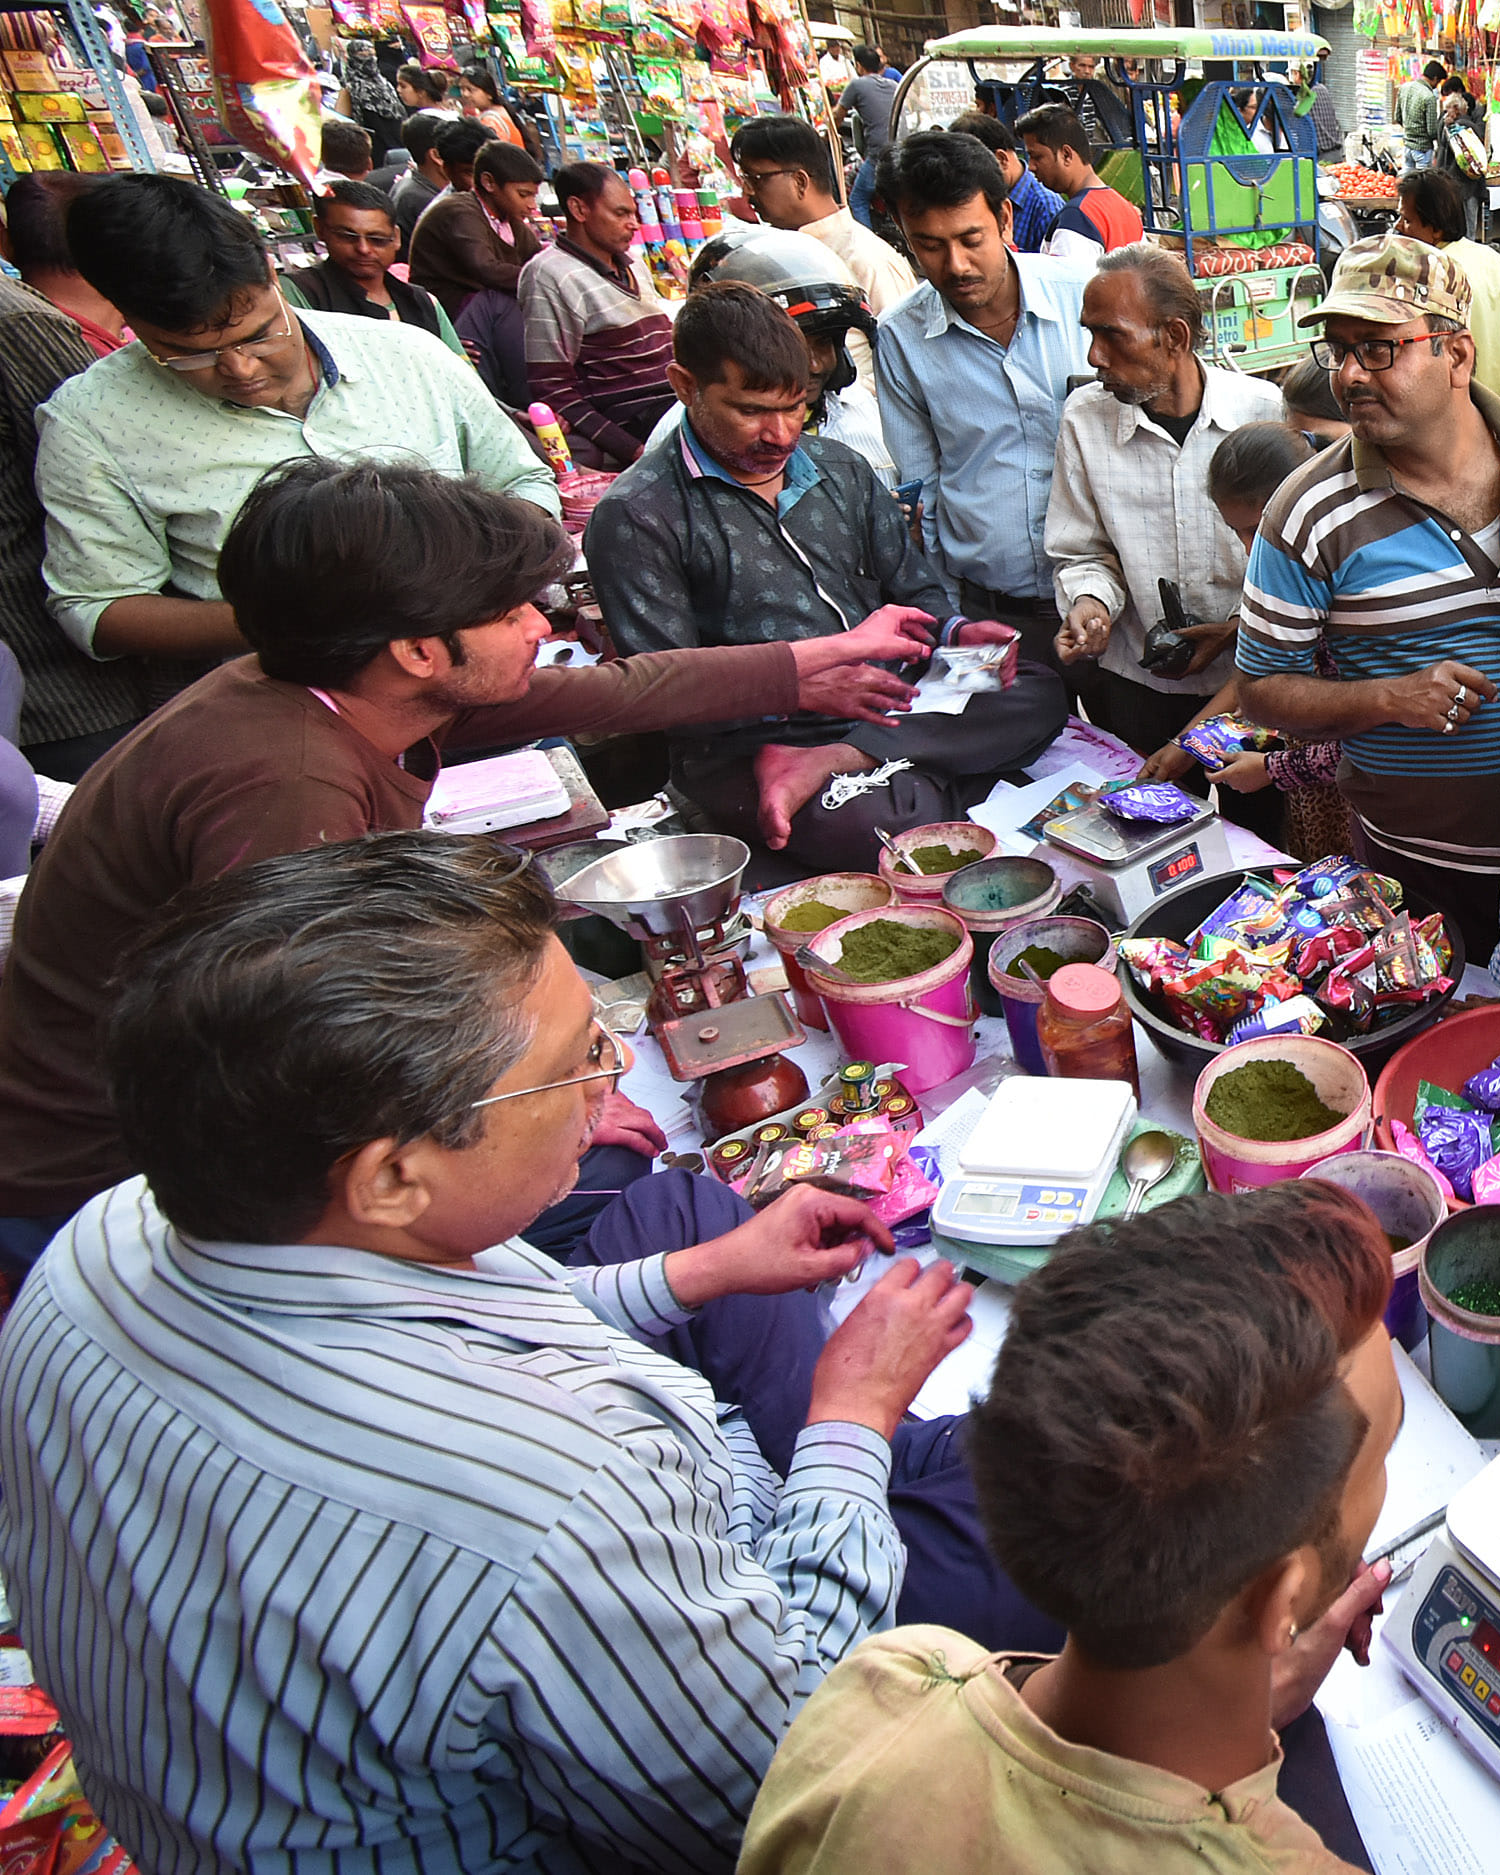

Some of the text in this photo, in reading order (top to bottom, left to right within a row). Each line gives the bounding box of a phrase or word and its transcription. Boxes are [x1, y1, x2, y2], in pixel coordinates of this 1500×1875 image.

[1210, 34, 1316, 57] Mini Metro
[1202, 312, 1238, 329] Mini
[1216, 330, 1239, 344] etro
[1167, 853, 1197, 878] 0.100
